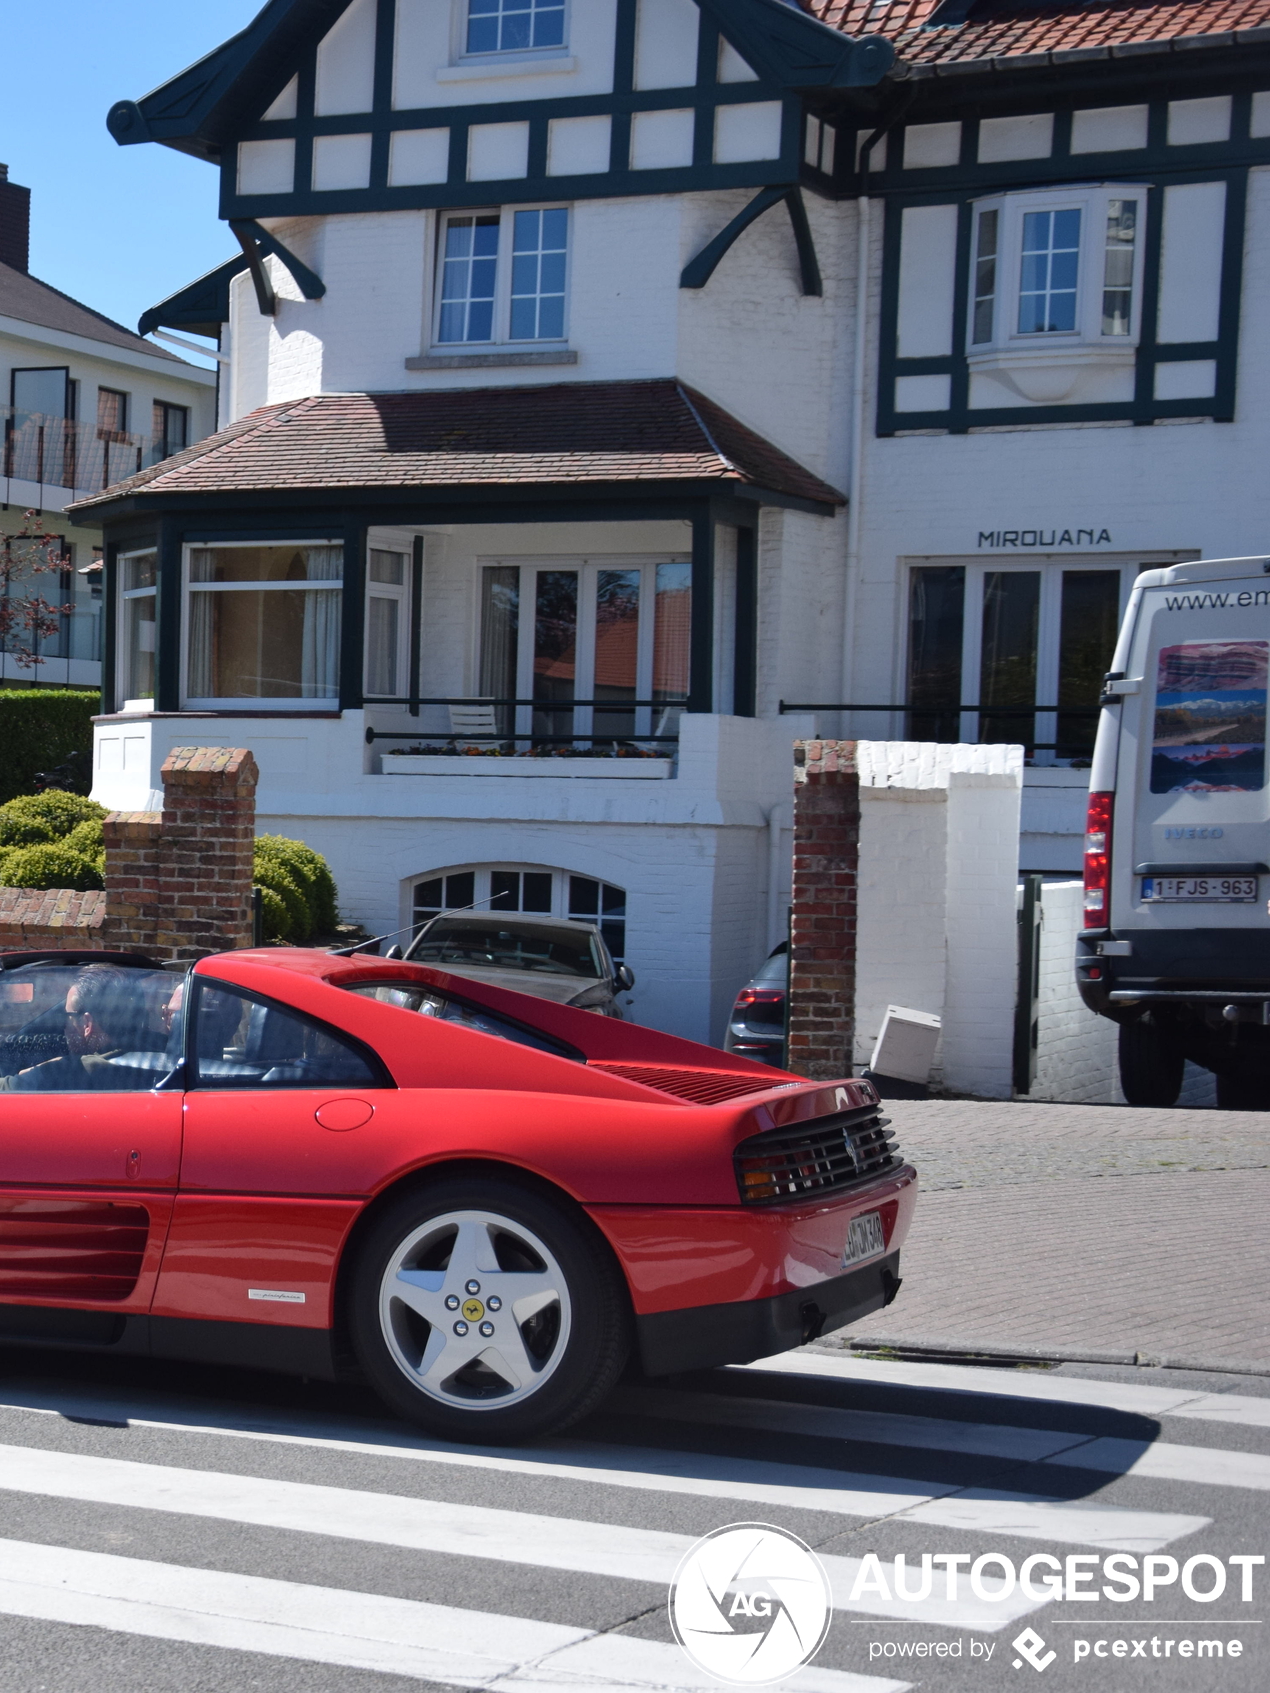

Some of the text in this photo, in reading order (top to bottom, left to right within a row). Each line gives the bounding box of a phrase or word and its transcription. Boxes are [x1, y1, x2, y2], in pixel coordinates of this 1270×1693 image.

[978, 529, 1111, 547] MIROUANA
[1164, 827, 1225, 840] IVECO
[1156, 880, 1255, 896] 1-FJS-963
